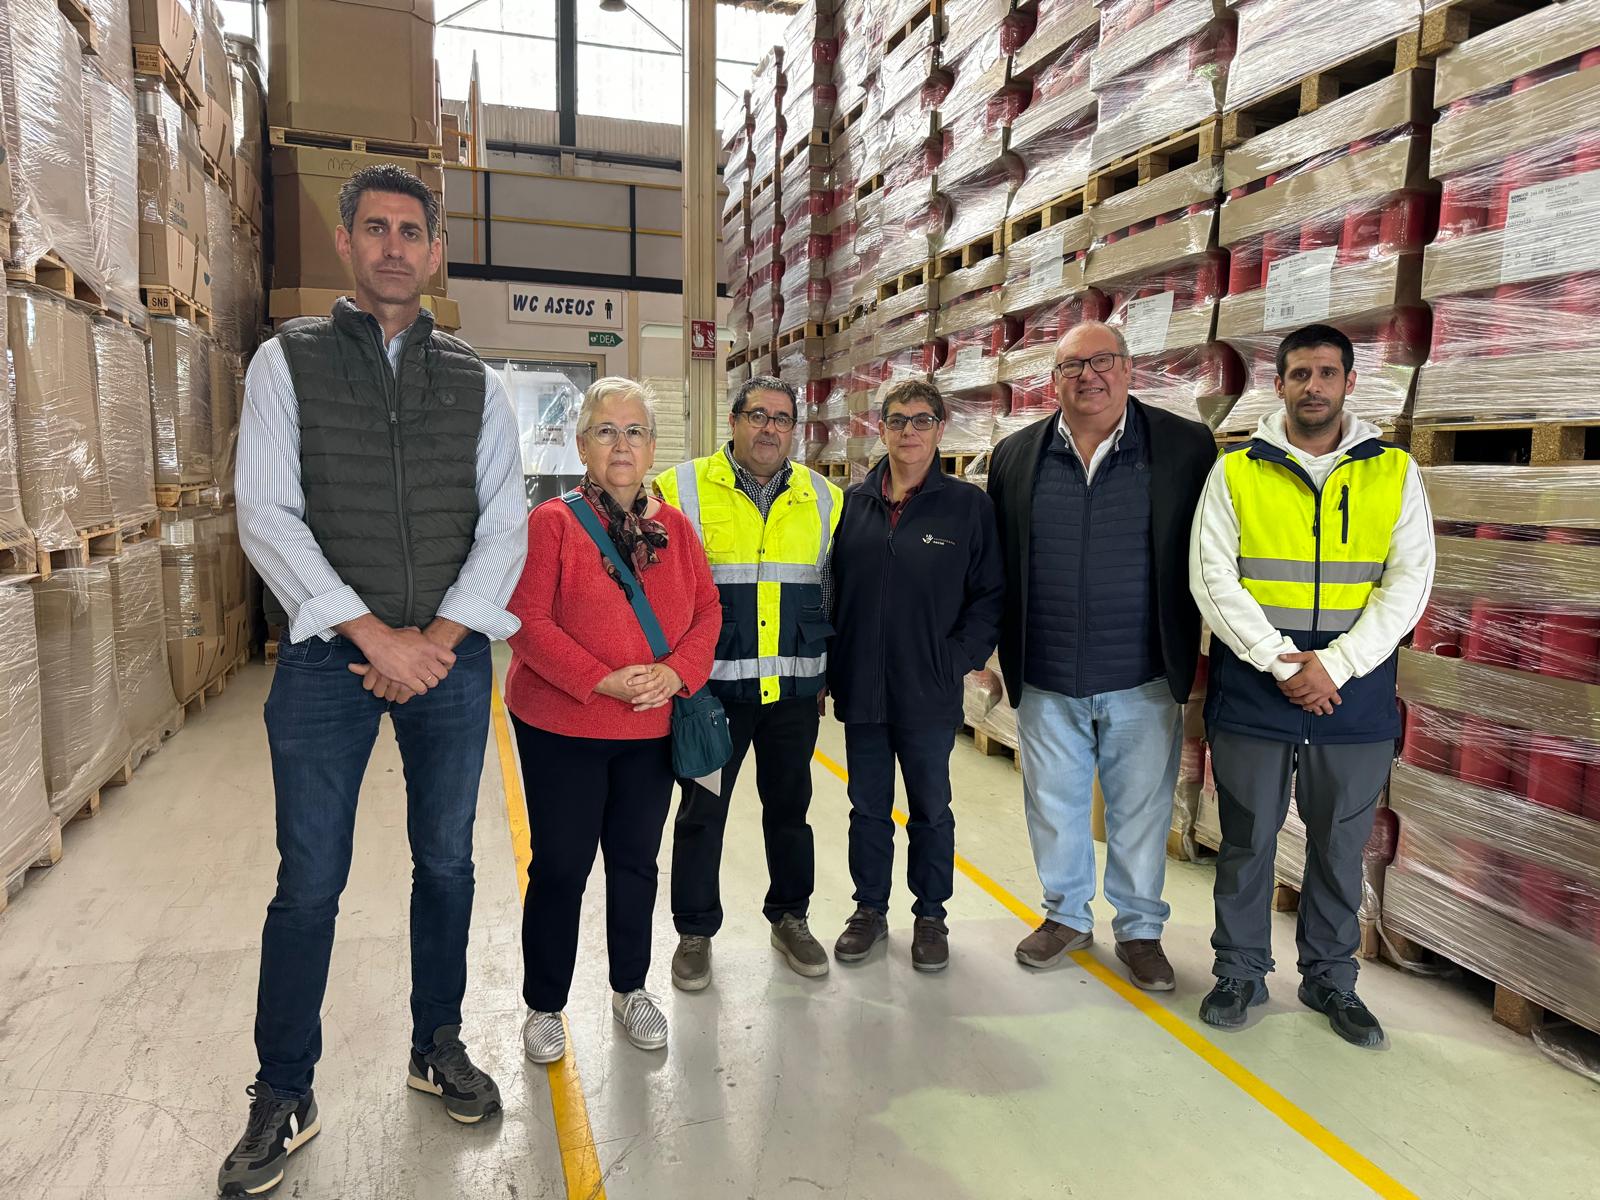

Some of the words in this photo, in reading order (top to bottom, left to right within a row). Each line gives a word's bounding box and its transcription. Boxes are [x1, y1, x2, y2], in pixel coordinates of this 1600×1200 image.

[151, 297, 169, 307] SNB
[513, 294, 539, 312] WC
[544, 296, 595, 316] ASEOS
[599, 334, 616, 344] DEA
